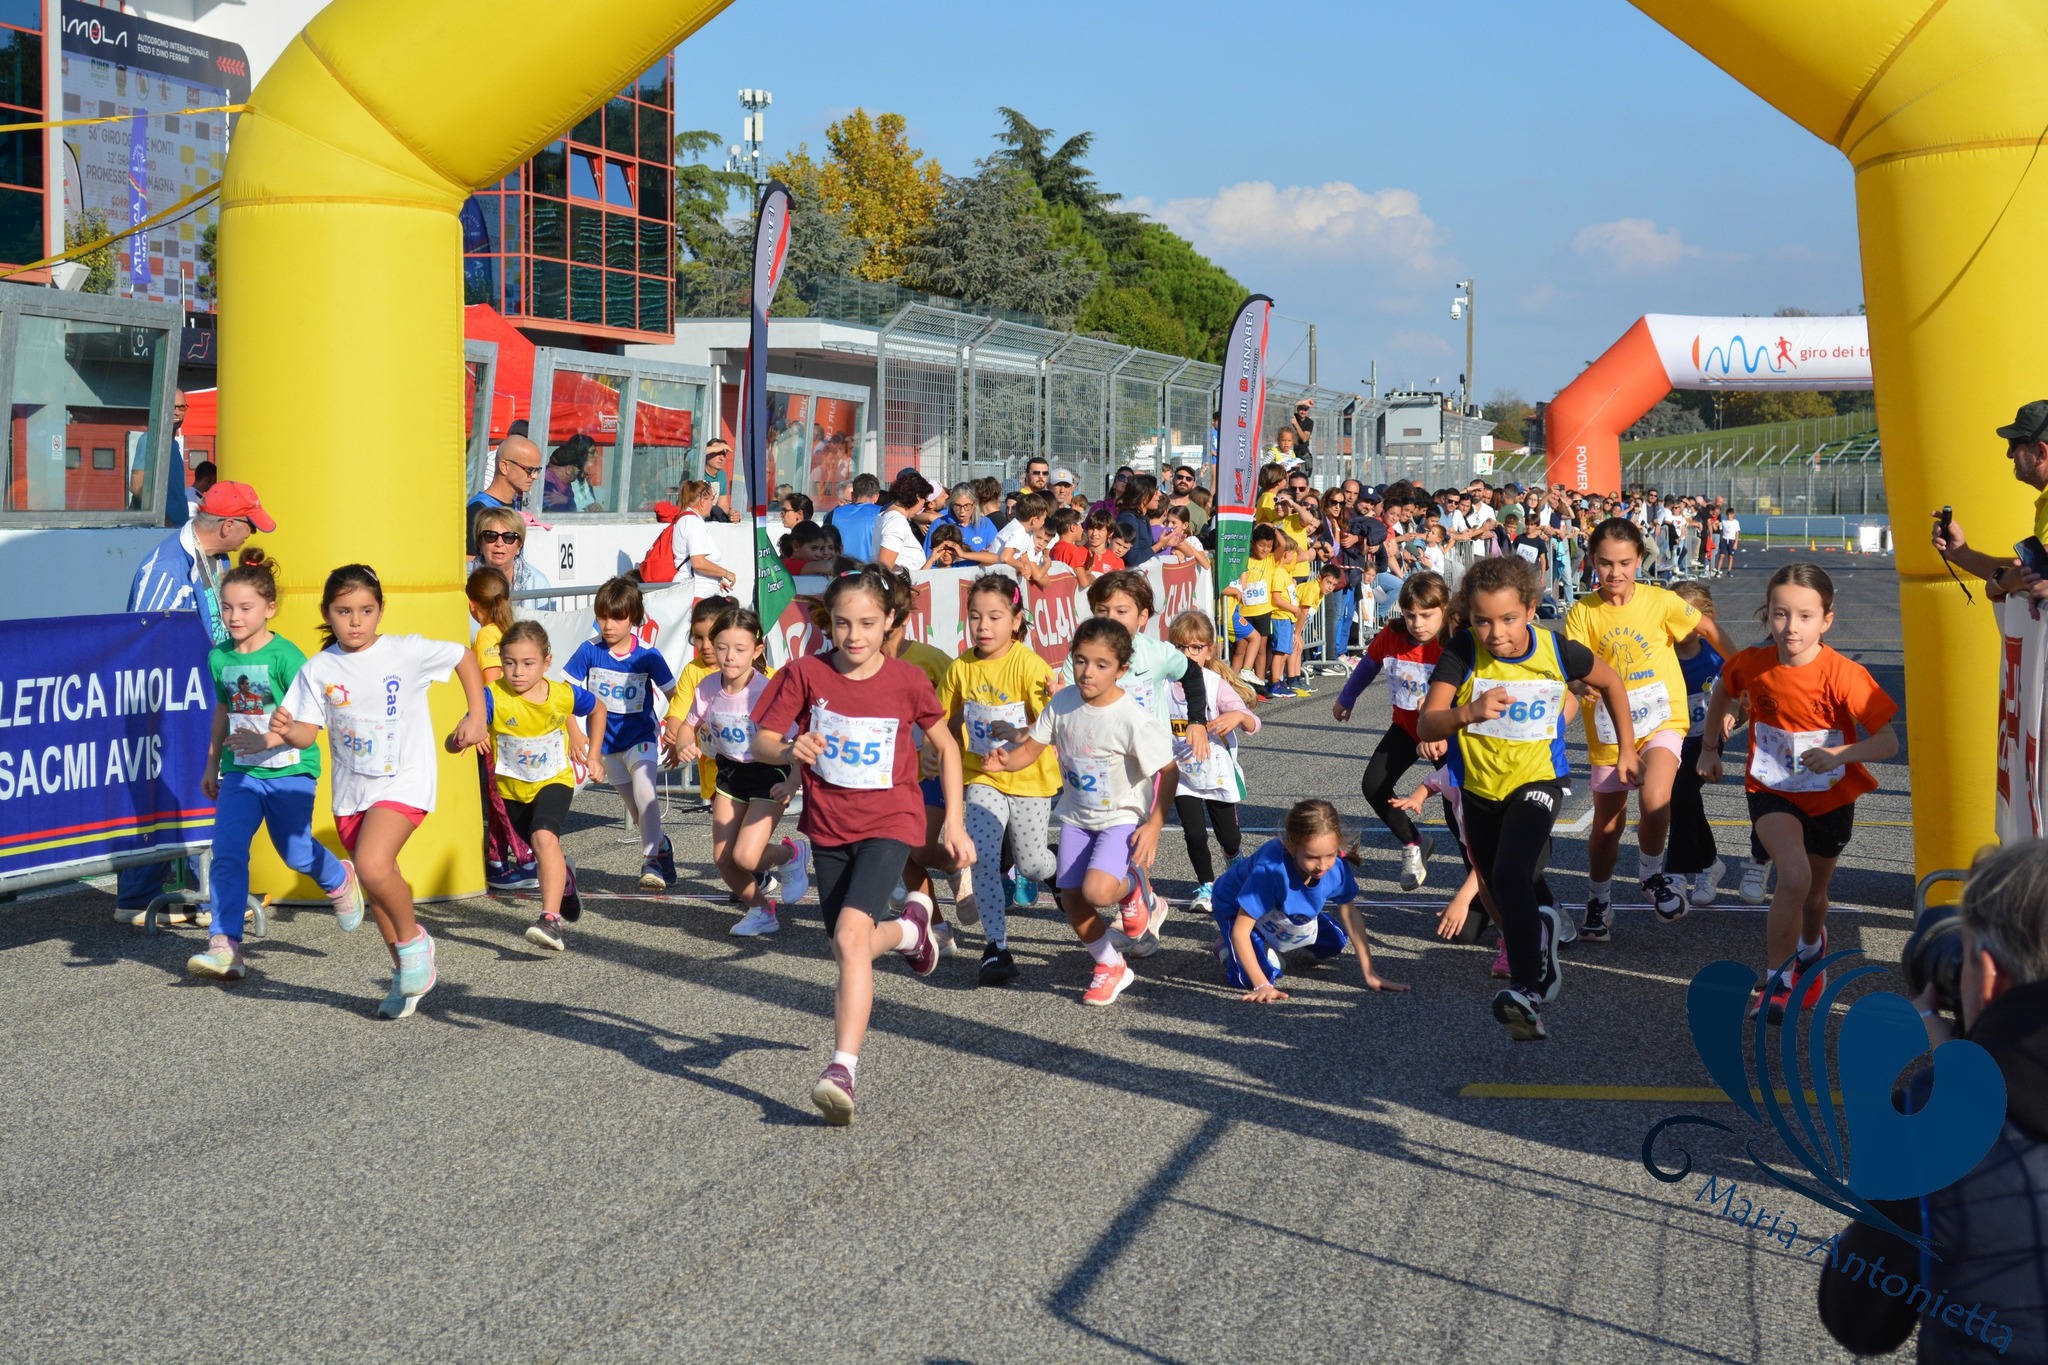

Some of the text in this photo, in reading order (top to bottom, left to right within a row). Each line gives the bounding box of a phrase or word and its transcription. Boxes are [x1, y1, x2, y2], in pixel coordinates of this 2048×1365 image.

[62, 15, 128, 48] IMOLA
[137, 33, 210, 59] AUTODROMO INTERNAZIONALE
[137, 43, 151, 54] ENZO
[156, 49, 169, 59] DINO
[169, 51, 190, 64] FERRARI
[102, 128, 121, 145] GIRO
[151, 138, 175, 156] MONTI
[86, 164, 128, 185] PROMESSE
[1240, 311, 1254, 392] BERNABEI
[1800, 346, 1828, 361] giro
[1832, 345, 1854, 358] dei
[1576, 445, 1588, 490] POWER
[560, 542, 574, 569] 26
[1246, 587, 1265, 599] 596
[1034, 596, 1077, 648] CLAI
[115, 667, 207, 716] IMOLA
[599, 682, 638, 700] 560
[1401, 679, 1427, 693] 431
[1500, 700, 1547, 721] 66
[711, 722, 746, 743] 549
[343, 734, 373, 755] 251
[823, 734, 881, 765] 555
[0, 734, 162, 800] SACMI AVIS
[518, 752, 548, 766] 274
[1062, 771, 1098, 792] 62
[1524, 790, 1554, 812] PUMA
